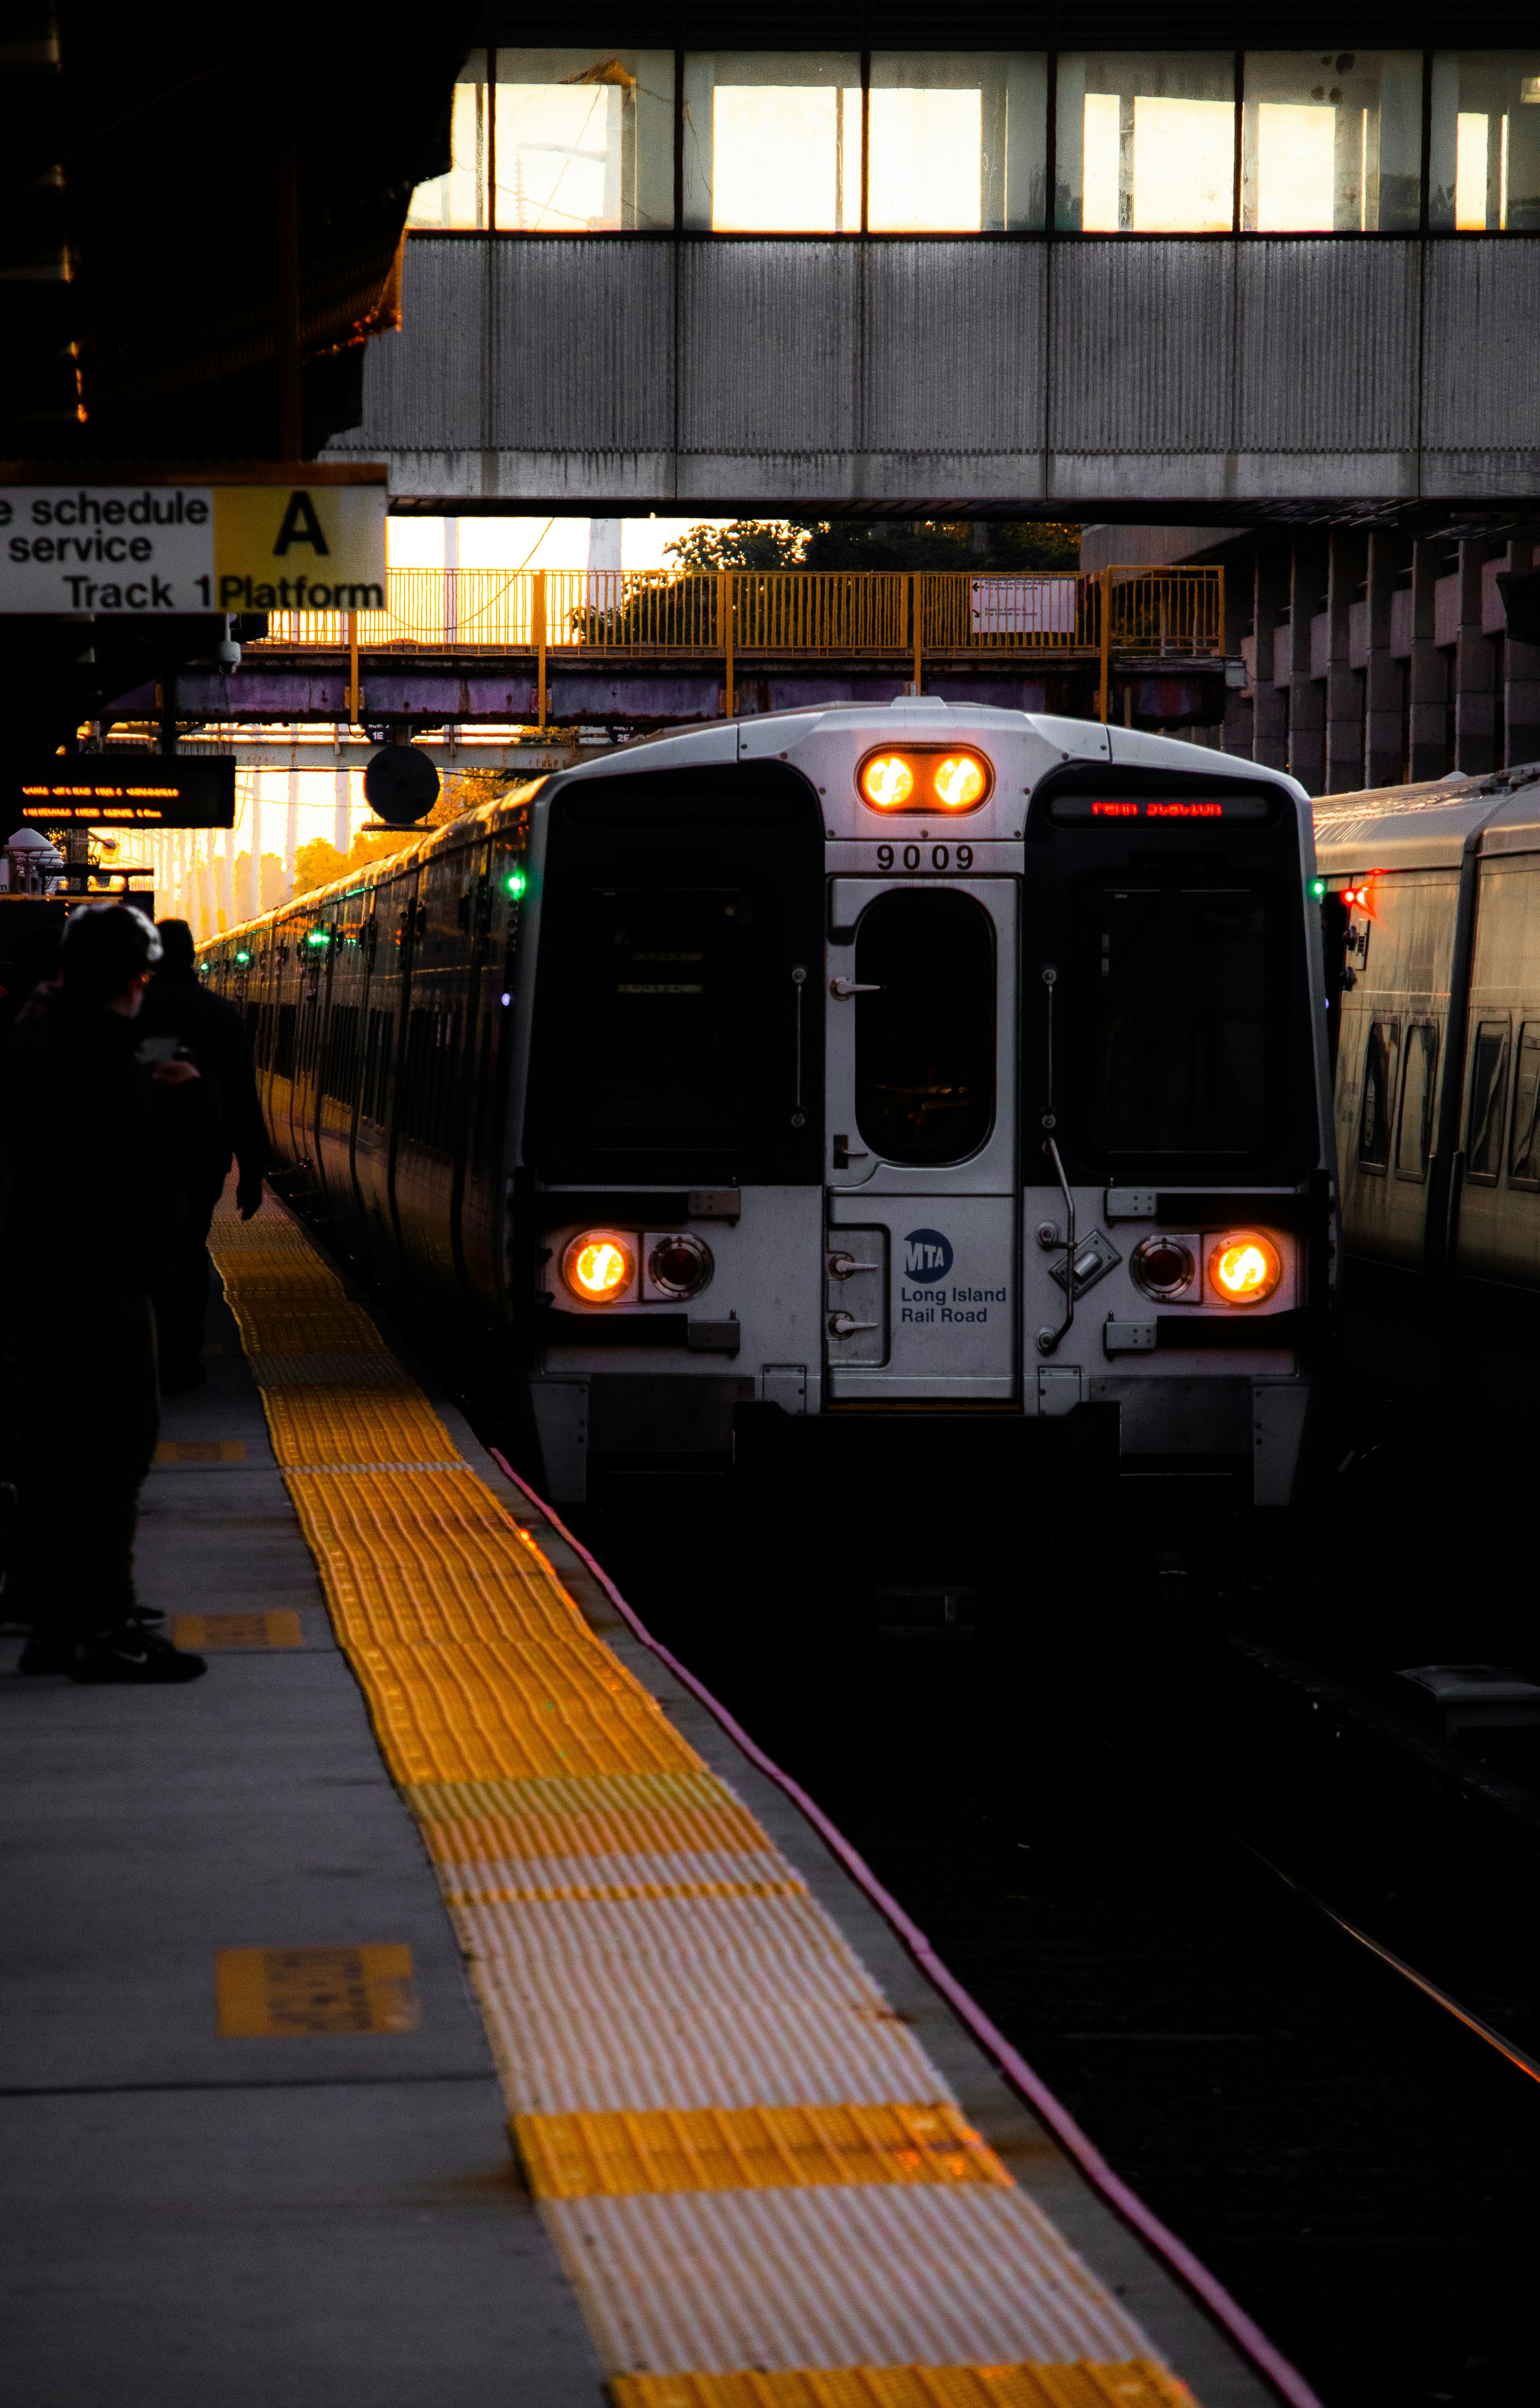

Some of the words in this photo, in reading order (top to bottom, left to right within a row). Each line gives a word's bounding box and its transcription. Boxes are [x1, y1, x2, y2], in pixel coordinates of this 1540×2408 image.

[32, 491, 208, 525] schedule
[273, 491, 329, 556] A
[10, 528, 152, 562] service
[62, 575, 173, 608] Track
[195, 576, 210, 607] 1
[220, 575, 383, 609] Platform
[877, 845, 974, 871] 9009
[904, 1241, 945, 1272] MTA
[901, 1287, 946, 1306] Long
[952, 1287, 1006, 1303] Island
[901, 1308, 935, 1323] Rail
[941, 1308, 987, 1323] Road
